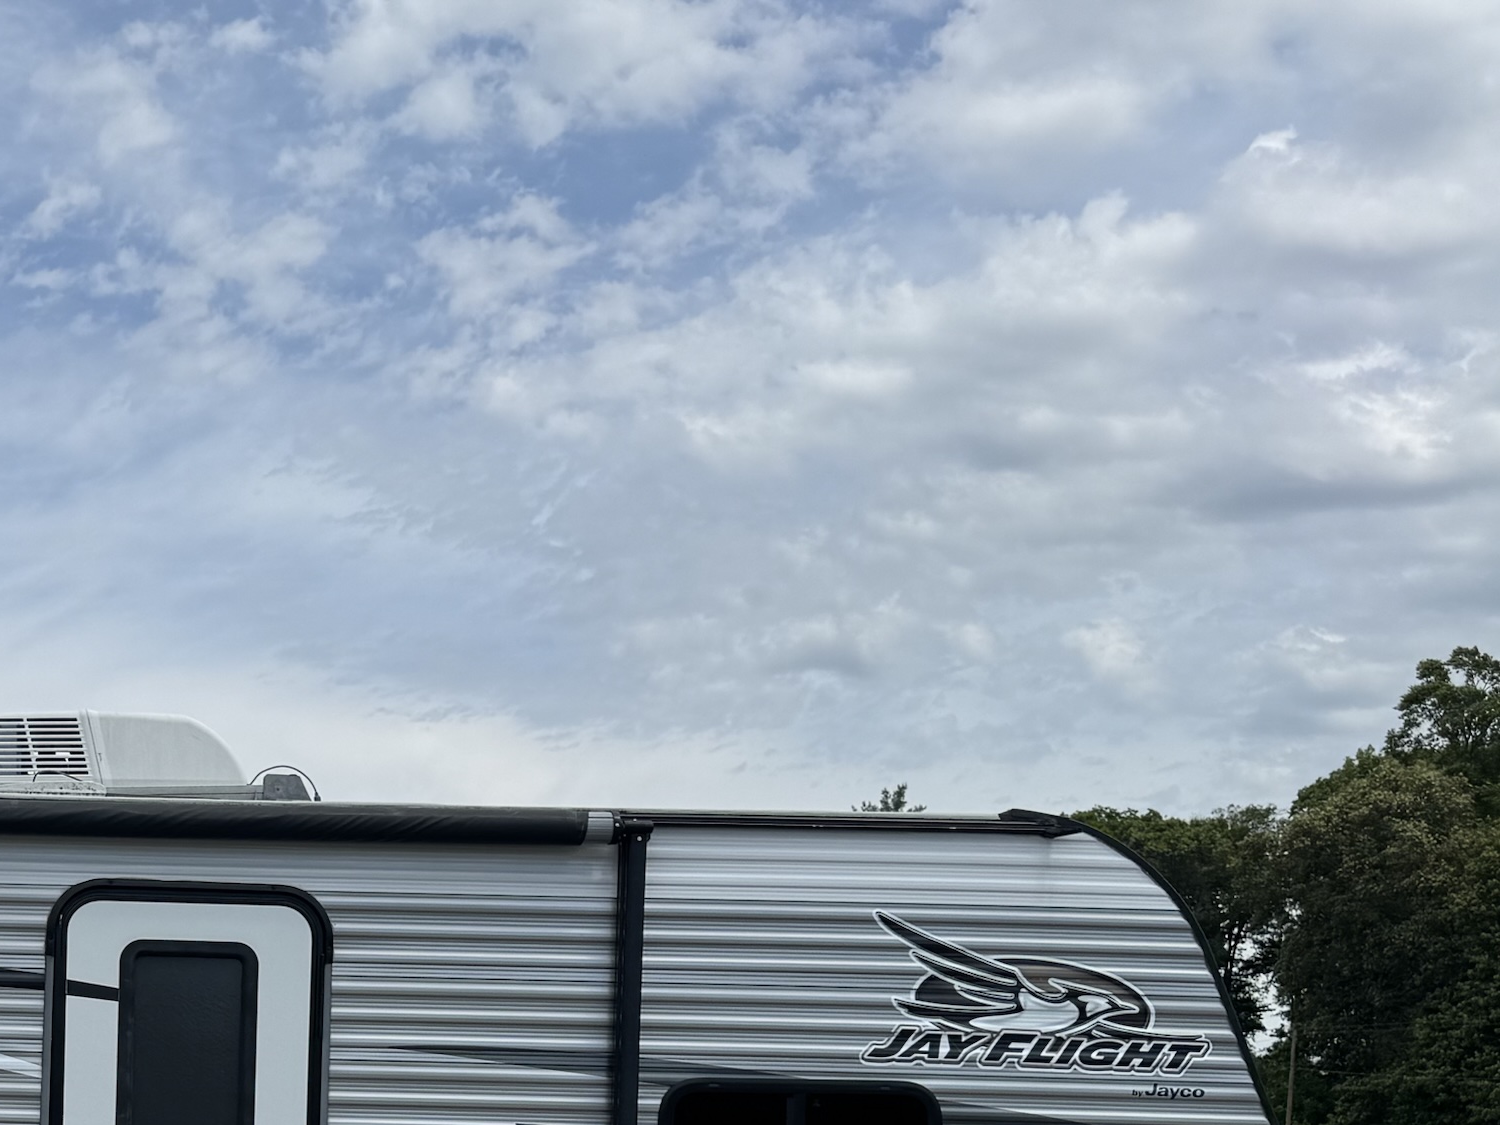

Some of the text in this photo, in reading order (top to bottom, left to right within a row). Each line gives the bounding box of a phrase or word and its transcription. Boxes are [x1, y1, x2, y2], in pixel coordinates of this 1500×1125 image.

[861, 1024, 1212, 1076] JAY FLIGHT
[1132, 1083, 1205, 1100] by Jayco
